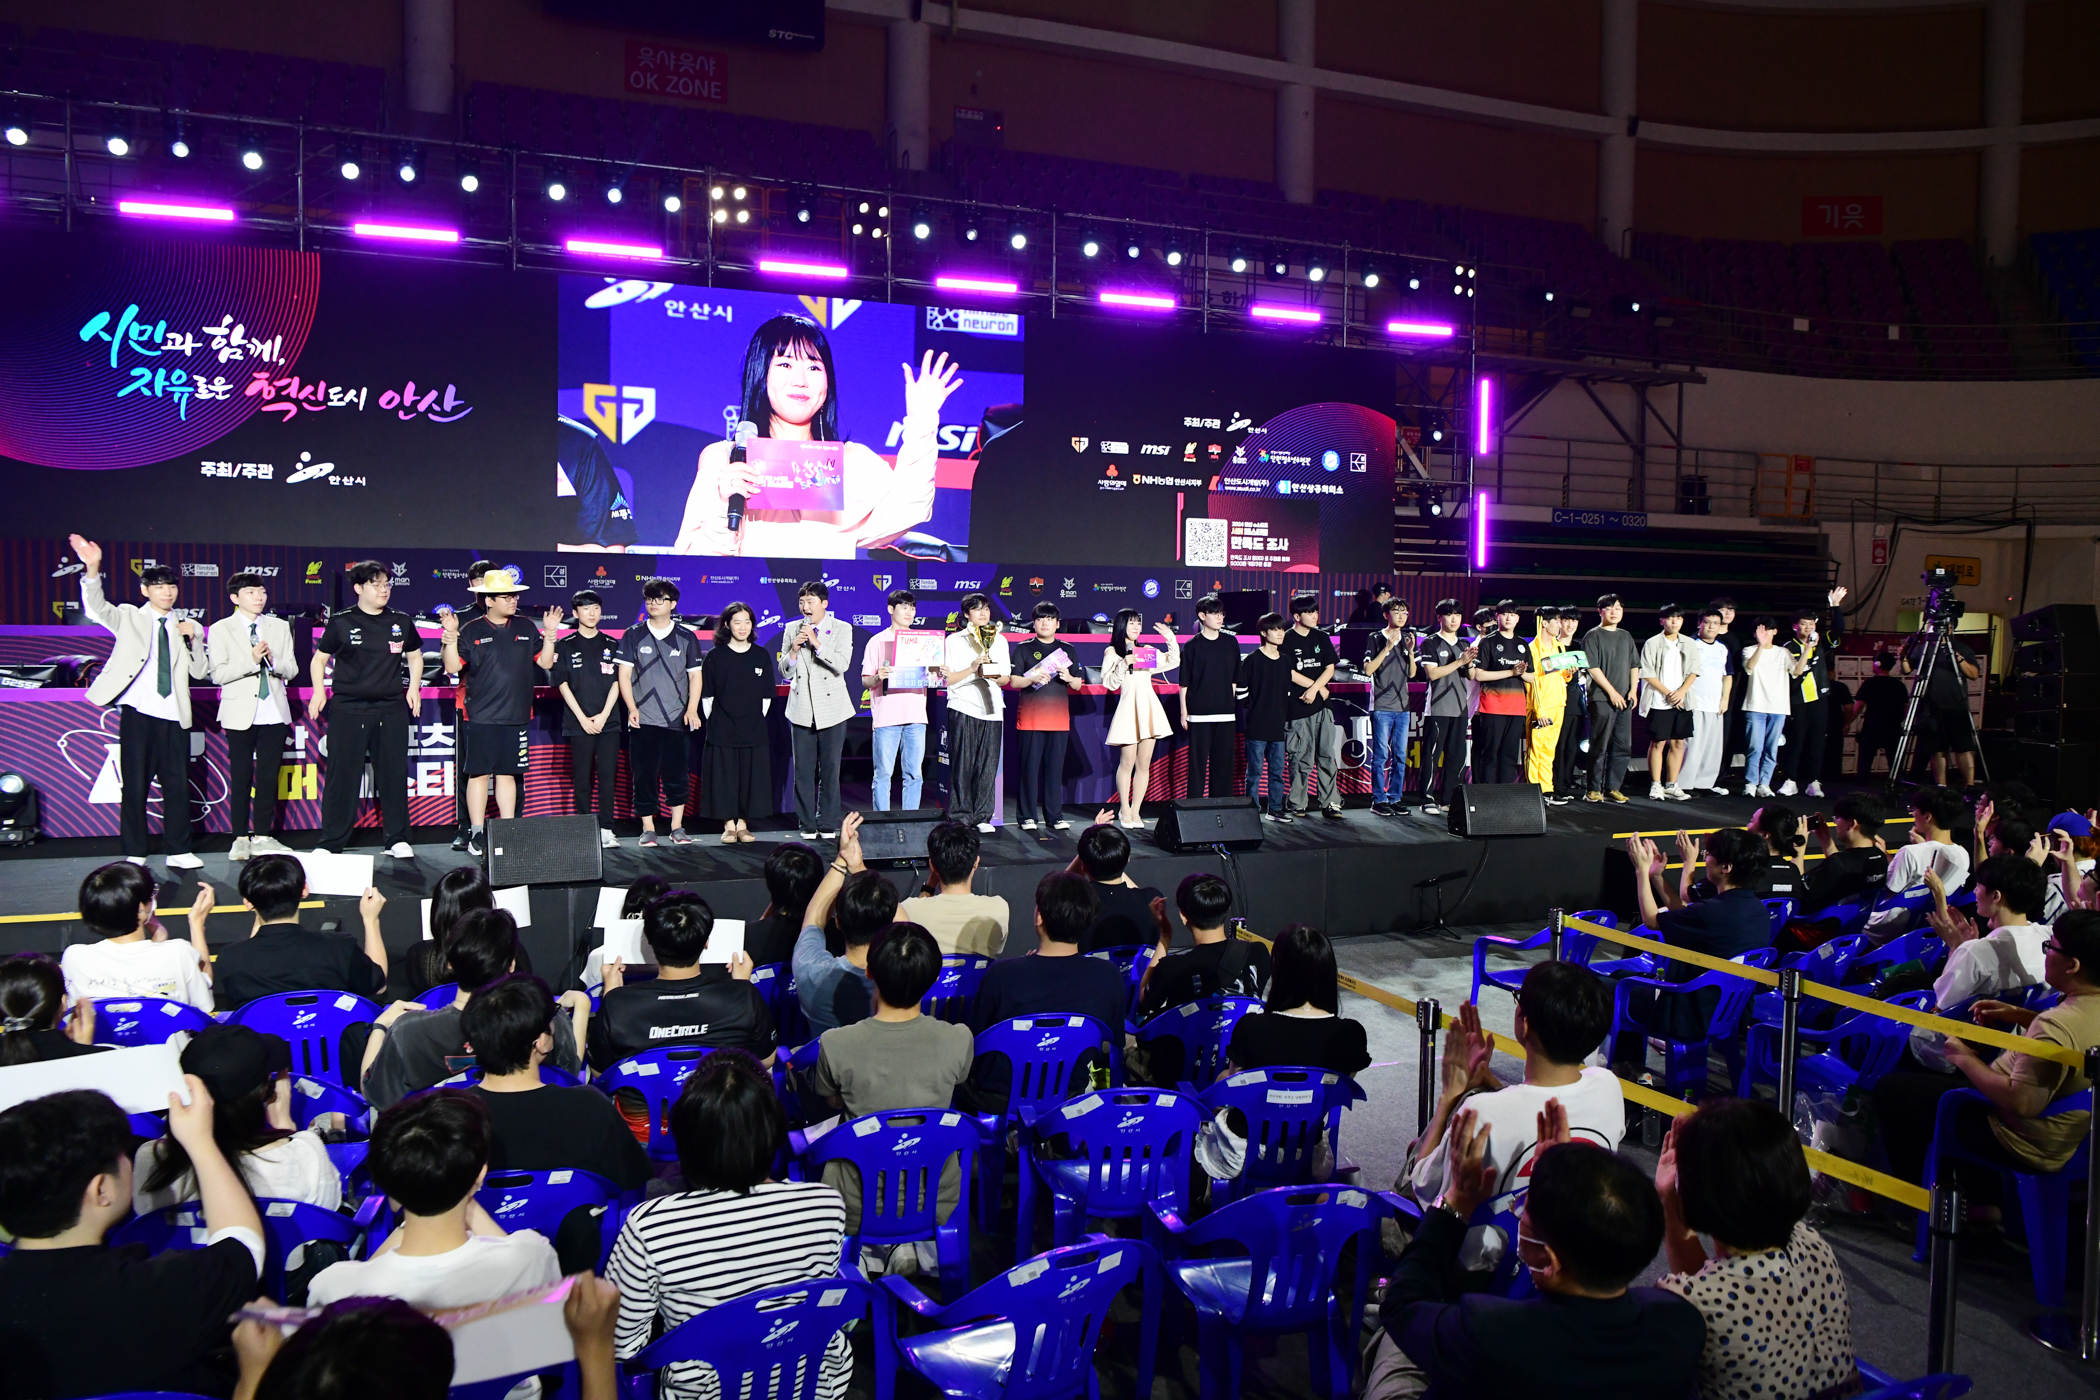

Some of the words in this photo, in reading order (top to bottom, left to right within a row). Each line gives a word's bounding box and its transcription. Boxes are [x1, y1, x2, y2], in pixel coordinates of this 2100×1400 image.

[768, 28, 793, 41] STC
[630, 70, 660, 91] OK
[666, 75, 721, 99] ZONE
[664, 300, 733, 323] 안산시
[79, 304, 203, 368] 시민과
[202, 314, 285, 366] 함께,
[963, 318, 1014, 332] neuron
[117, 367, 233, 421] 자유로운
[245, 372, 367, 422] 혁신도시
[379, 381, 473, 422] 안산
[200, 461, 274, 480] 주최/주관
[328, 476, 366, 487] 안산시
[1554, 511, 1605, 525] C-1-0251
[1622, 515, 1646, 527] 0320
[1230, 536, 1264, 550] 만족도
[1266, 538, 1289, 551] 조사
